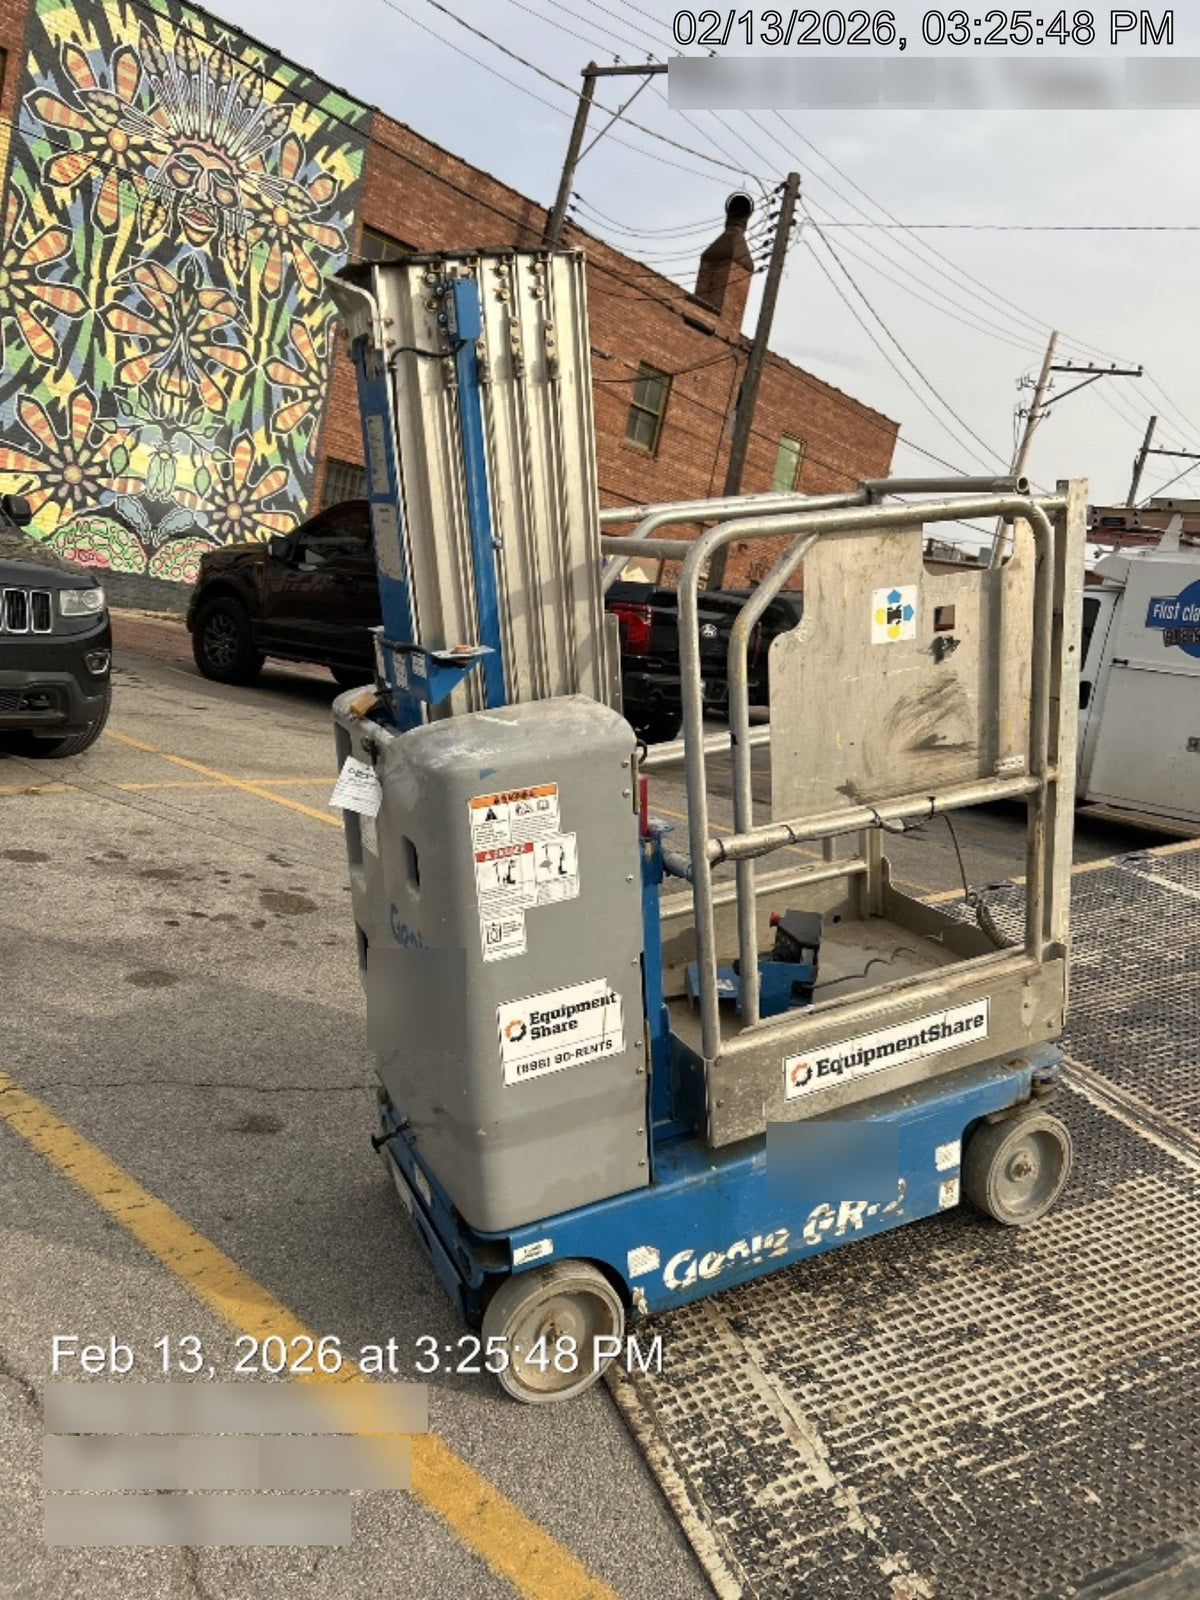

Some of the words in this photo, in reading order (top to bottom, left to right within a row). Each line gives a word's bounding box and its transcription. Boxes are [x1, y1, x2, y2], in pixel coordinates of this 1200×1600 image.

[1153, 601, 1180, 619] First
[529, 992, 617, 1026] Equipment
[530, 1019, 578, 1040] Share
[816, 1013, 984, 1077] EquipmentShare
